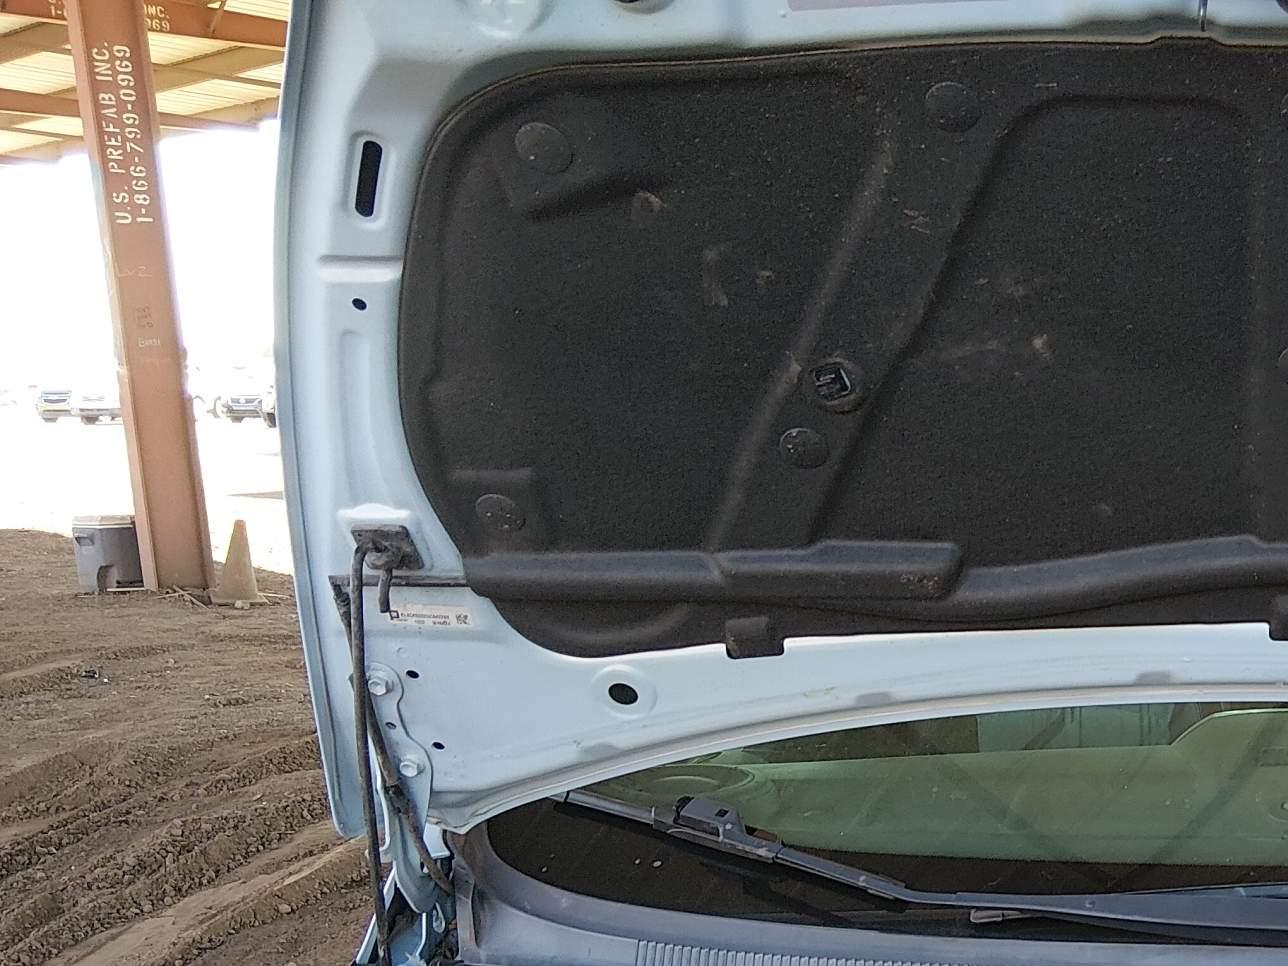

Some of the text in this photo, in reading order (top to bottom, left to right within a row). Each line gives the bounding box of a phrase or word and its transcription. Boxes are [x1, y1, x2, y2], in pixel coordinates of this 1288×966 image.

[92, 42, 132, 224] U.S. PREFAB INC.
[112, 45, 154, 222] 1-866-799-0969
